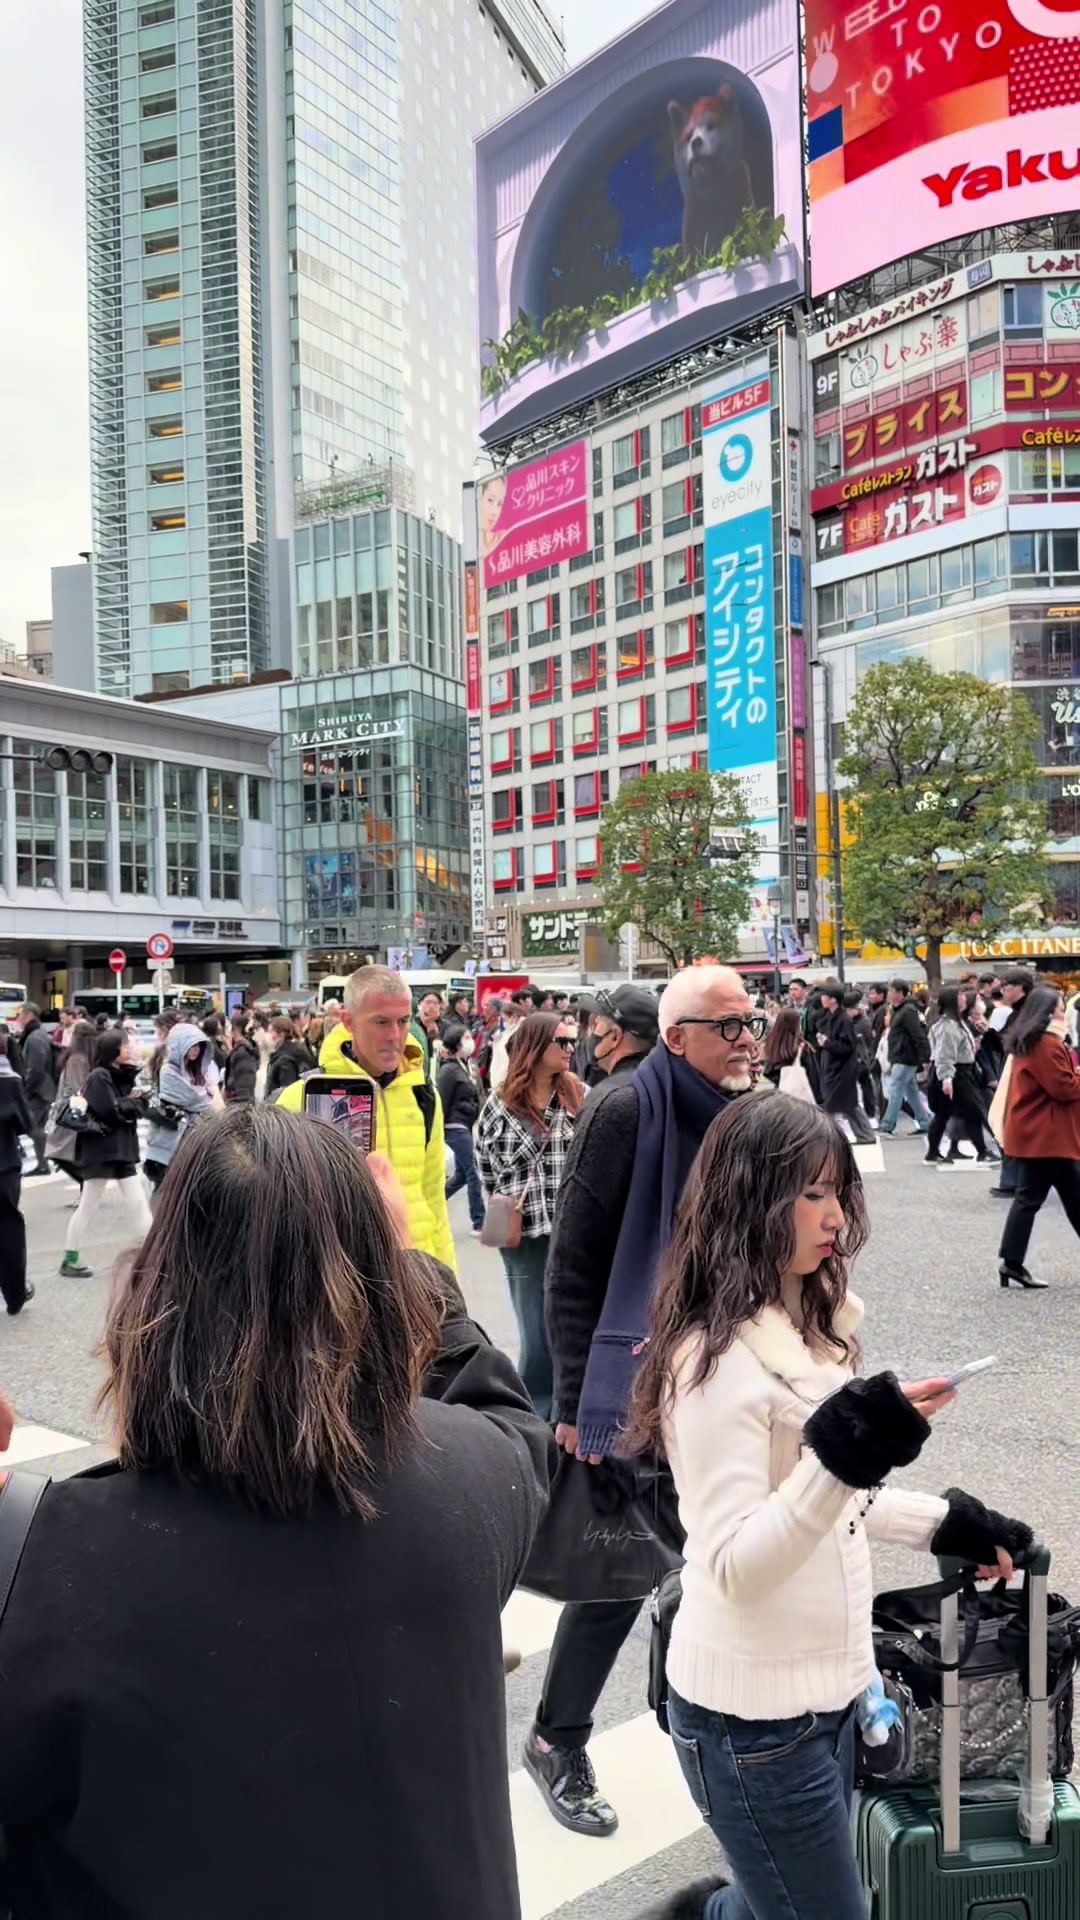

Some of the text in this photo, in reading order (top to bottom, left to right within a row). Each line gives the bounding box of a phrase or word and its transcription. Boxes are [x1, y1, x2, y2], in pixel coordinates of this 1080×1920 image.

[890, 5, 941, 48] TO
[845, 20, 1002, 110] TOKYO
[825, 277, 954, 348] しゃぶしゃぶバイキング
[883, 316, 958, 370] しゃぶ葉
[816, 370, 838, 396] 9F
[1005, 371, 1080, 400] コン
[708, 384, 763, 423] 当ビル5F
[845, 388, 966, 458] プライス
[525, 455, 581, 493] 品川スキン
[916, 438, 977, 480] ガスト
[526, 477, 575, 511] クリニック
[711, 480, 762, 511] eyecity
[973, 480, 999, 497] ガスト
[884, 487, 958, 540] ガスト
[497, 521, 582, 574] 品川美容外科
[817, 522, 843, 550] 7F
[712, 552, 743, 728] アイシティ
[744, 543, 768, 724] コンタクトの
[291, 719, 405, 745] MARK CITY
[318, 712, 372, 728] SHIBUYA
